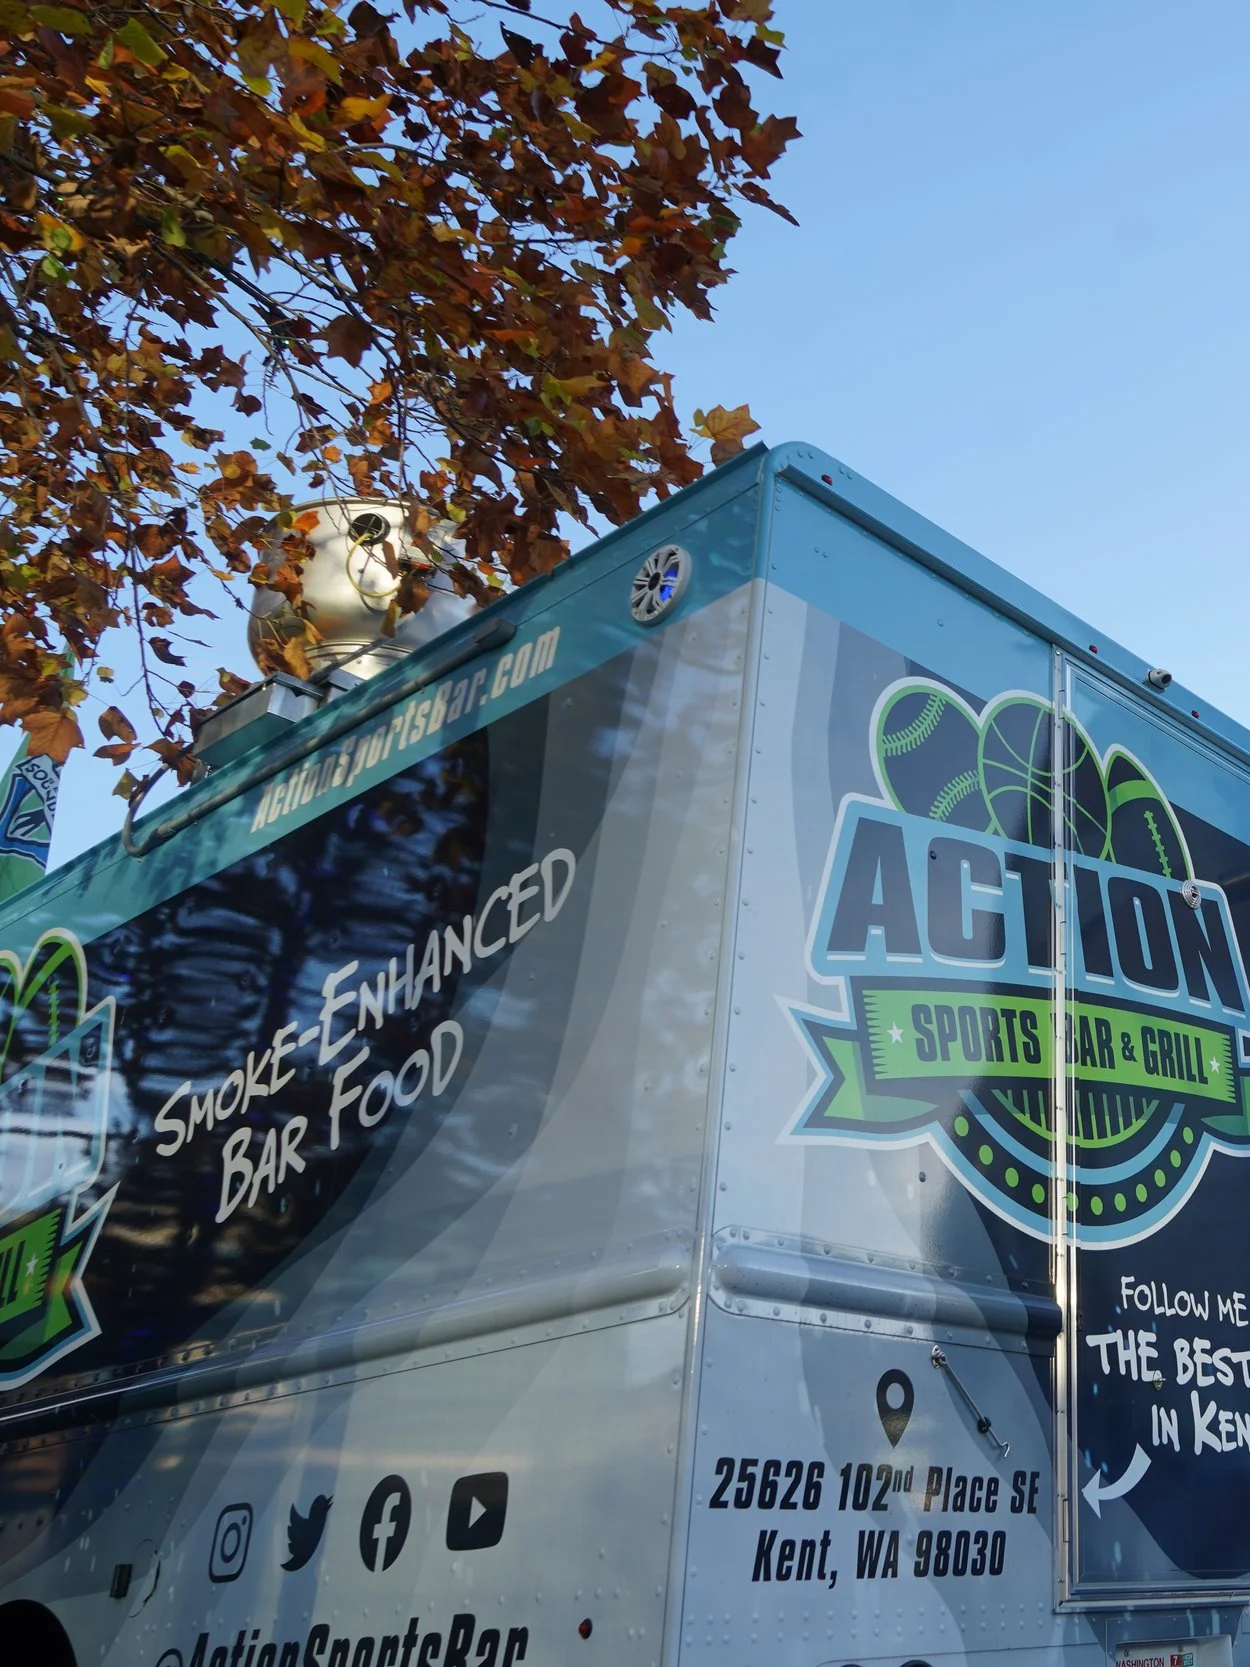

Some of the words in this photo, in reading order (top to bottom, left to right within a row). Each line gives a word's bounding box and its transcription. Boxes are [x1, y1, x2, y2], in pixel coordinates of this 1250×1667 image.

[251, 626, 562, 834] ActionSportsBar.com
[826, 816, 1246, 1014] ACTION
[910, 1003, 1042, 1064] SPORTS
[1121, 1031, 1138, 1063] &
[1141, 1025, 1210, 1085] GRILL
[215, 1116, 309, 1225] BAR
[329, 1020, 465, 1151] FOOD
[1120, 1275, 1210, 1322] FOLLOW
[1217, 1291, 1249, 1328] ME
[1085, 1329, 1159, 1383] THE
[1151, 1404, 1181, 1453] IN
[709, 1457, 826, 1511] 25626
[838, 1462, 915, 1512] 102nd
[923, 1466, 1000, 1514] Place
[1009, 1470, 1041, 1515] SE
[751, 1529, 838, 1590] Kent,
[856, 1529, 899, 1580] WA
[913, 1529, 1007, 1578] 98030
[1116, 1656, 1165, 1667] WASHINGTON
